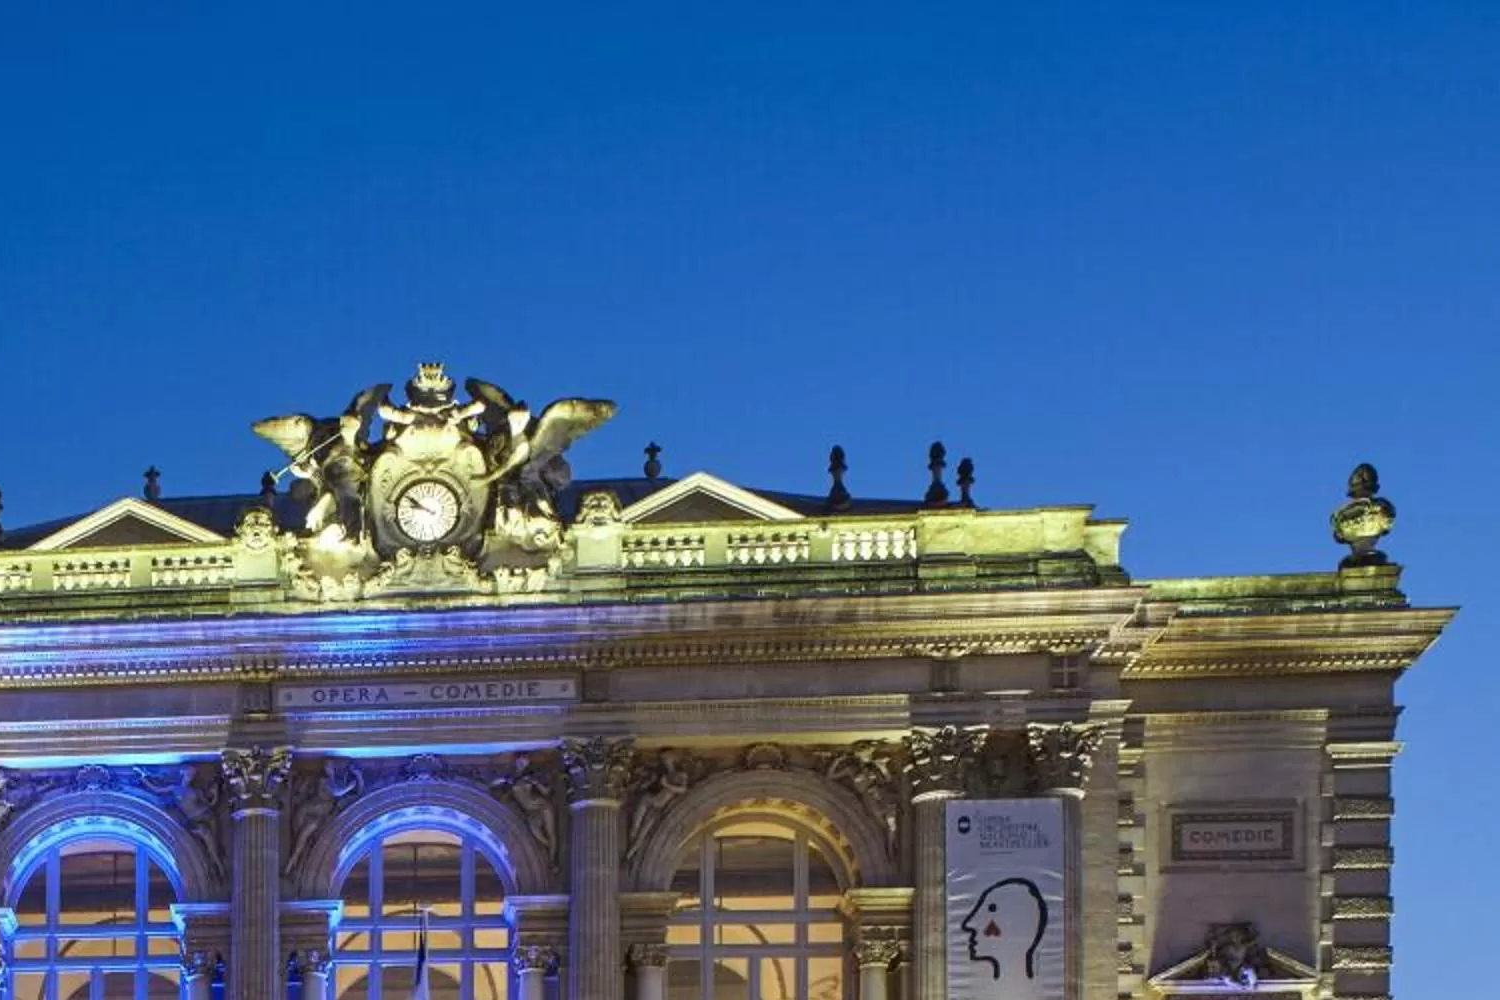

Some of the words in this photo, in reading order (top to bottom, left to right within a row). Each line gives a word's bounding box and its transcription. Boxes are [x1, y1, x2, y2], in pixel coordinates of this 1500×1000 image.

[310, 687, 390, 703] OPERA
[430, 681, 542, 700] COMEDIE
[1189, 828, 1275, 844] COMEDIE
